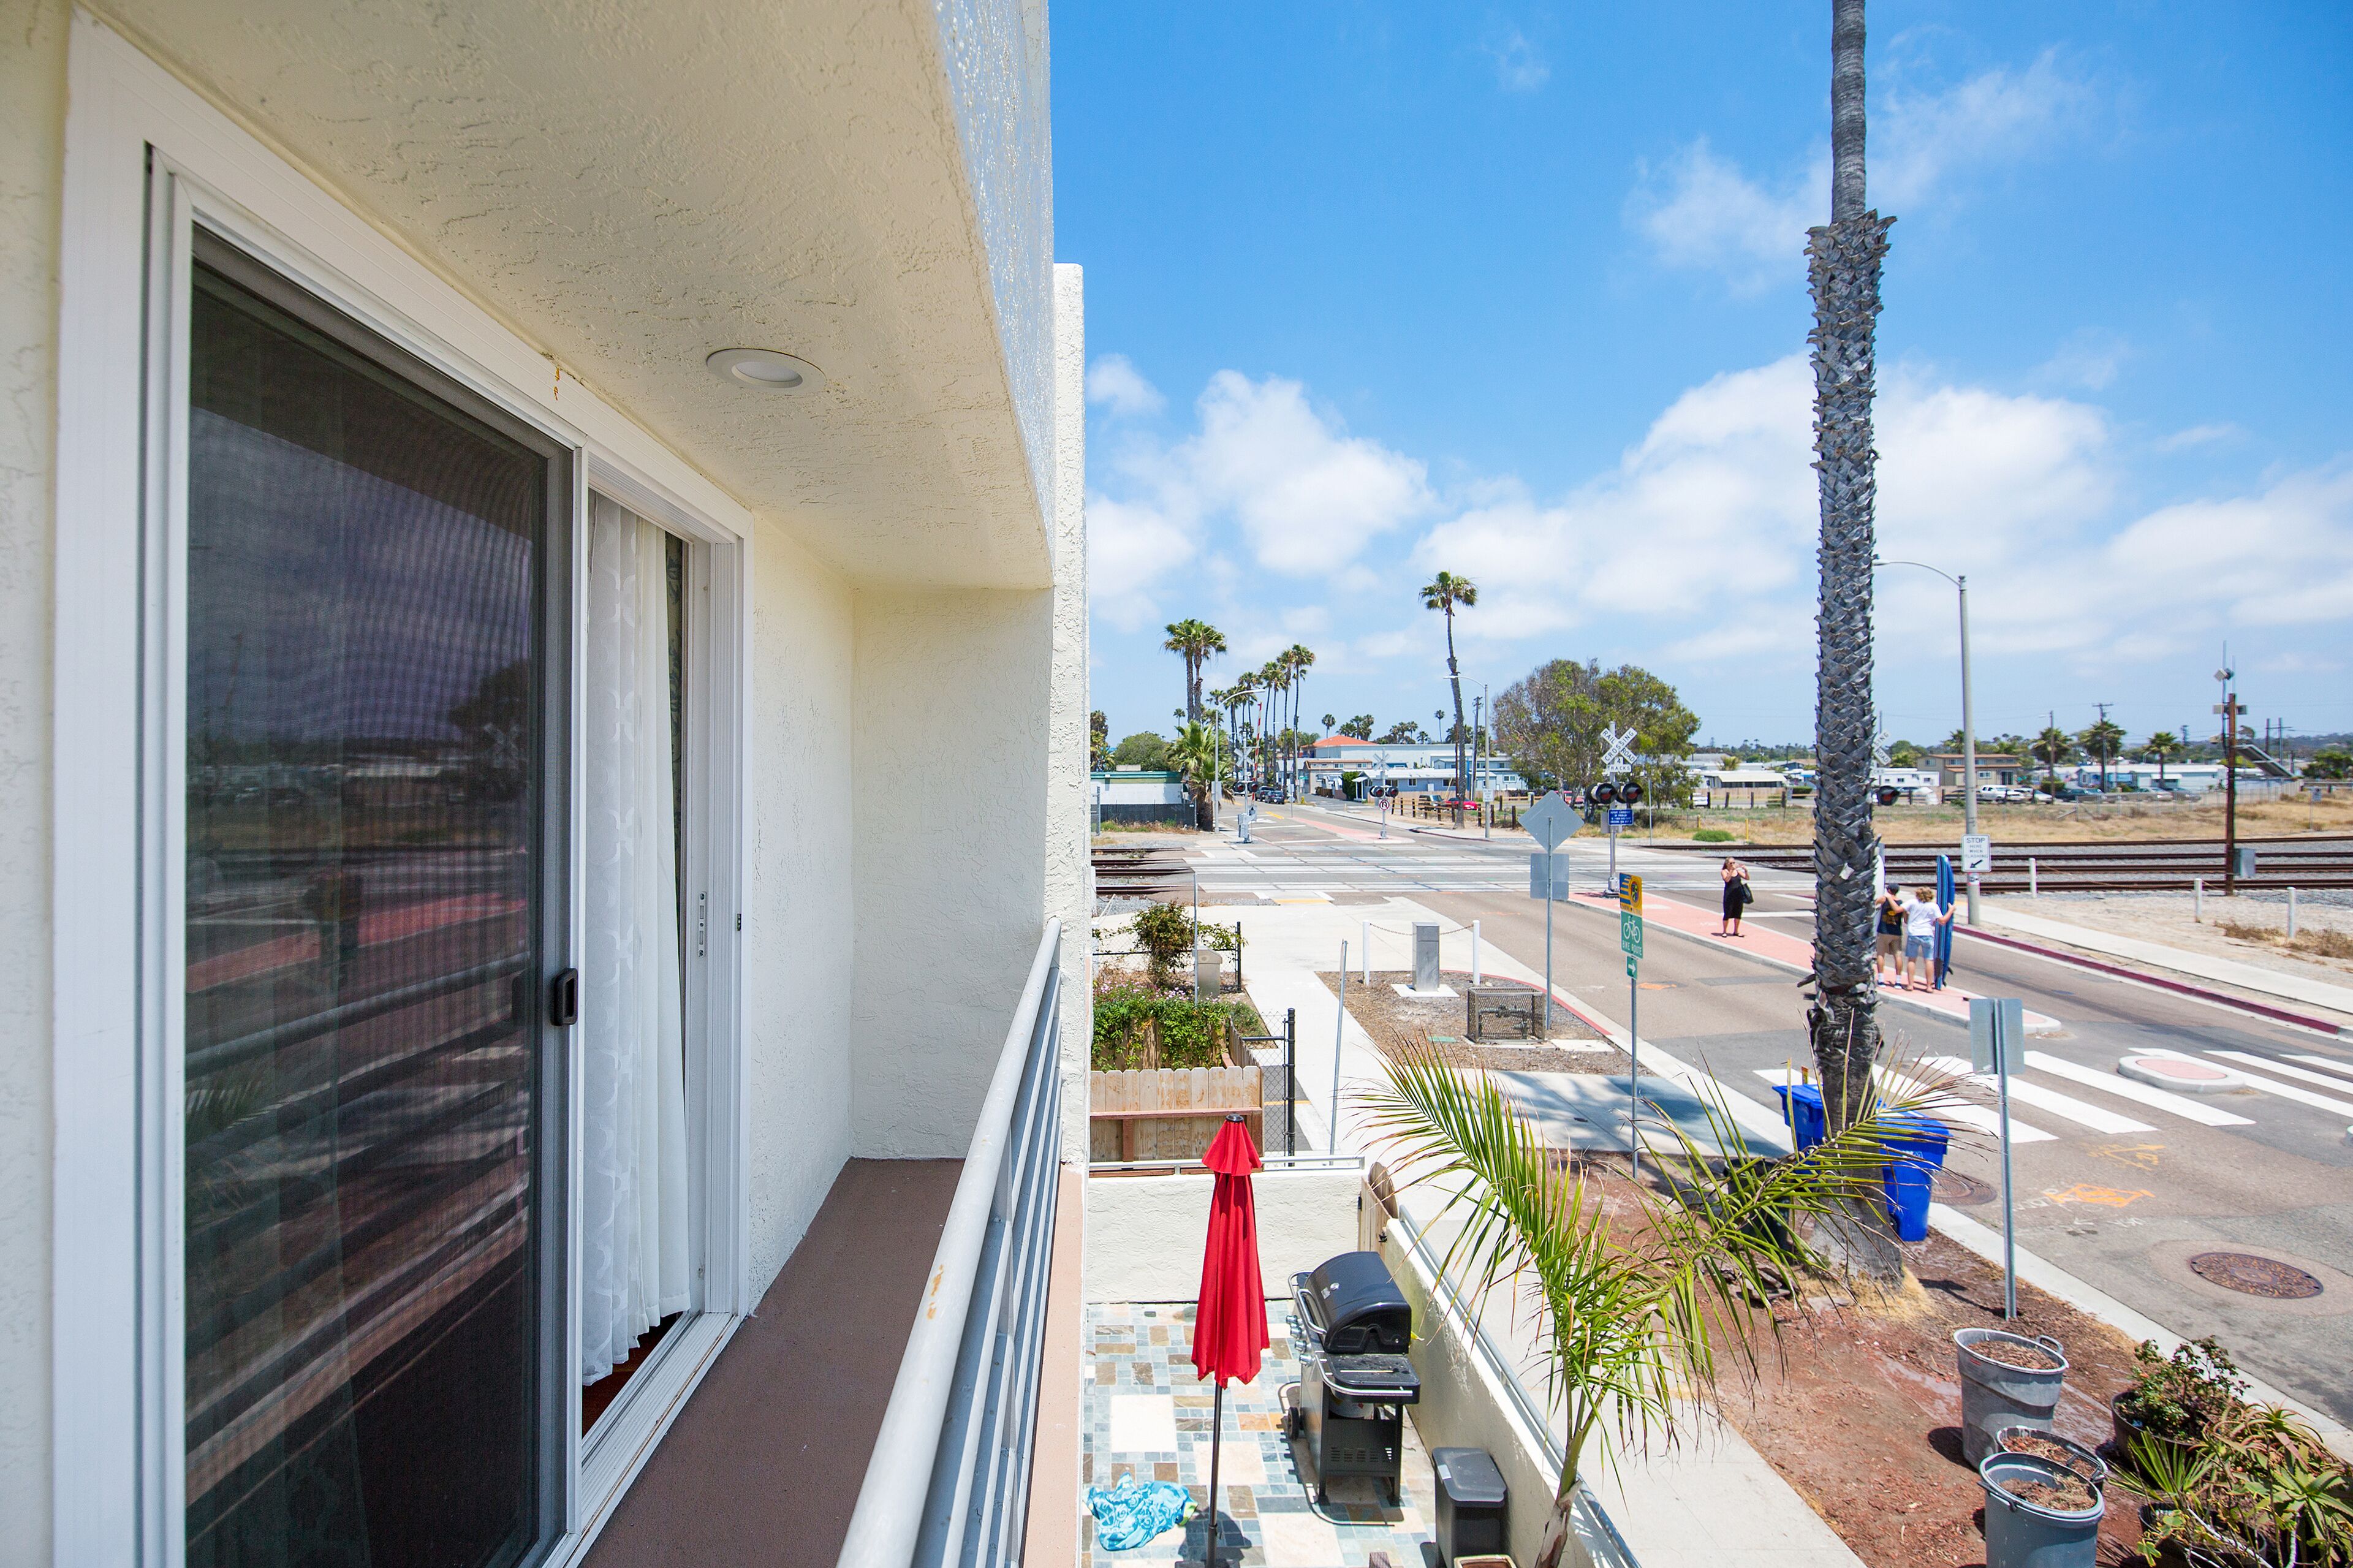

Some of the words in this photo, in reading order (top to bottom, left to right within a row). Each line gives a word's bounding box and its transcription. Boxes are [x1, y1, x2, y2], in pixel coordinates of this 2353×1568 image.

[1602, 730, 1616, 744] RAIL
[1620, 747, 1635, 762] ROAD
[1604, 731, 1634, 761] CROSSING
[1875, 748, 1889, 763] ROAD
[1631, 944, 1642, 955] ROUTE
